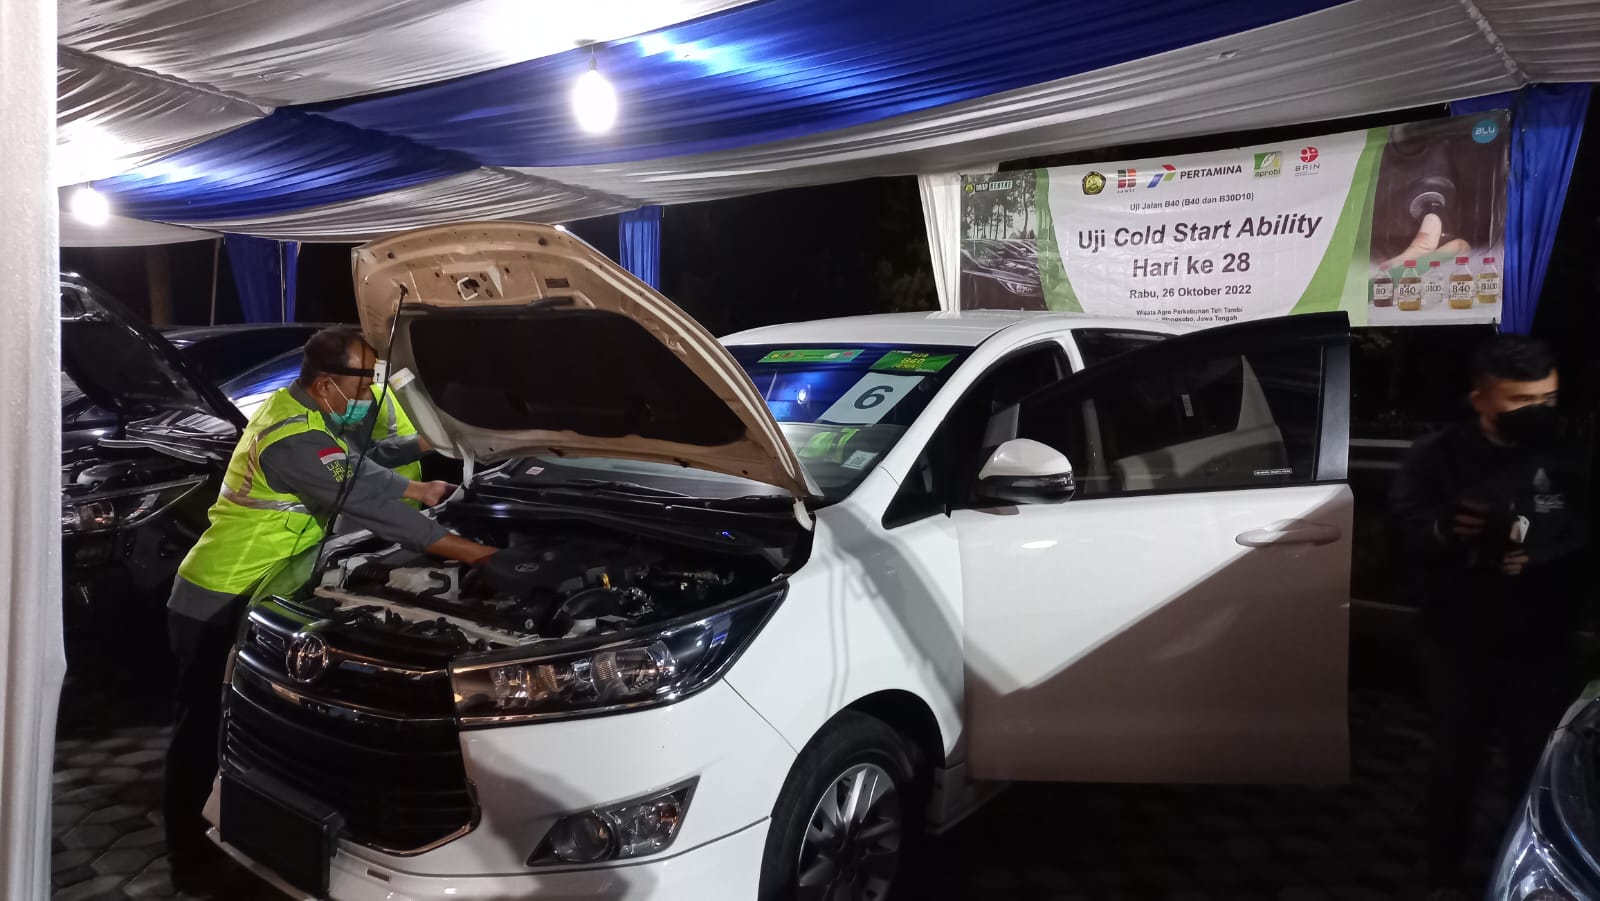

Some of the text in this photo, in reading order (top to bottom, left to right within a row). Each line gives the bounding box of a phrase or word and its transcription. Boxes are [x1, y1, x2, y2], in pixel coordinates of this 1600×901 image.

[1475, 125, 1495, 135] BLU
[1180, 165, 1242, 180] PERTAMINA
[1255, 168, 1281, 177] aprobi
[1295, 163, 1320, 171] BRIN
[1130, 192, 1254, 212] Uji Jalan B40 (B40 dan B30D10)
[1078, 213, 1323, 253] Uji Cold Start Ability
[1132, 252, 1251, 277] Hari ke 28
[1129, 284, 1252, 299] Rabu, 26 Oktober 2022
[1157, 309, 1172, 317] Agro
[854, 385, 894, 410] 6
